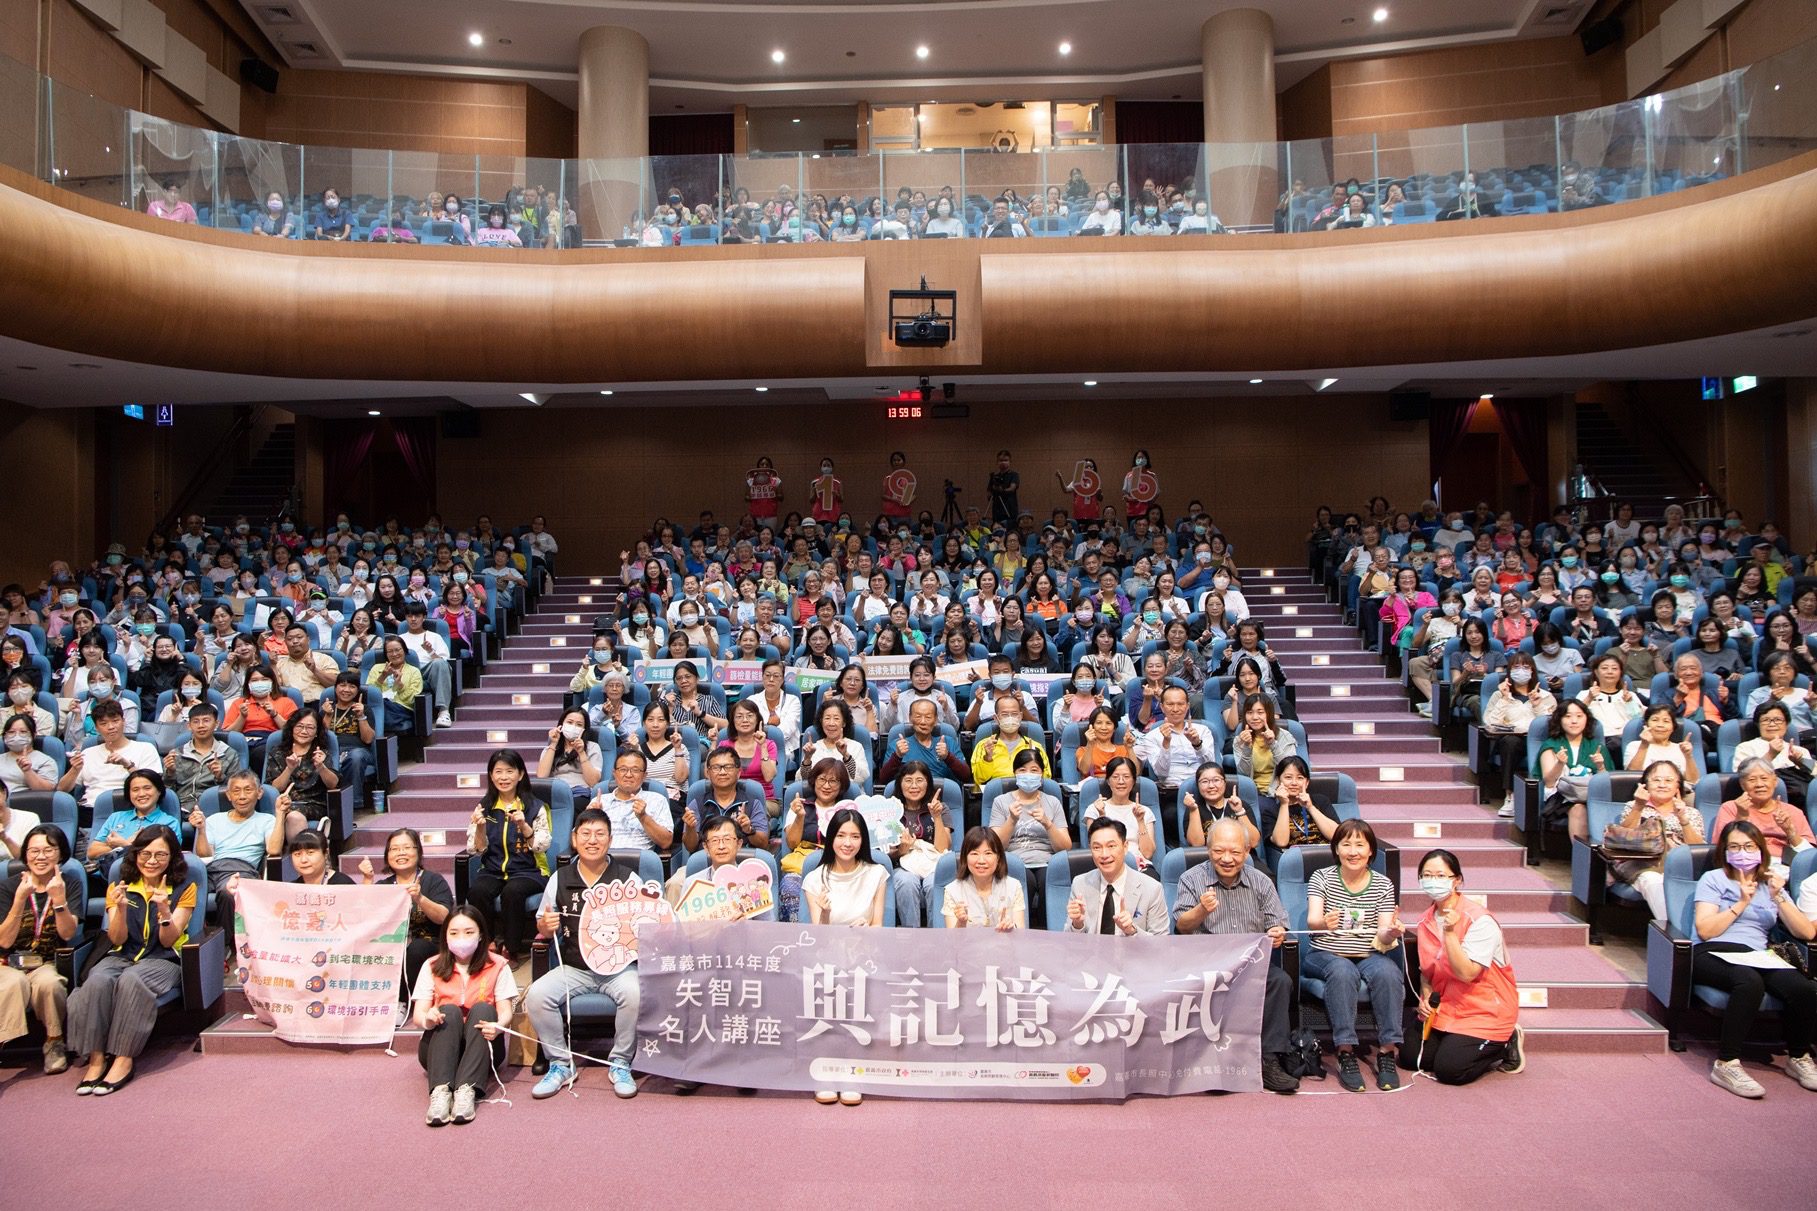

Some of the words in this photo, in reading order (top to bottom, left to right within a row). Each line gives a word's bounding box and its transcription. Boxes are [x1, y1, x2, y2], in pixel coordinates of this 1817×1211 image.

[584, 880, 638, 909] 1966
[681, 887, 728, 917] 1966
[660, 953, 782, 973] 嘉義市114年度
[675, 977, 763, 1009] 失智月
[796, 962, 1236, 1048] 與記憶為武
[658, 1014, 782, 1045] 名人講座
